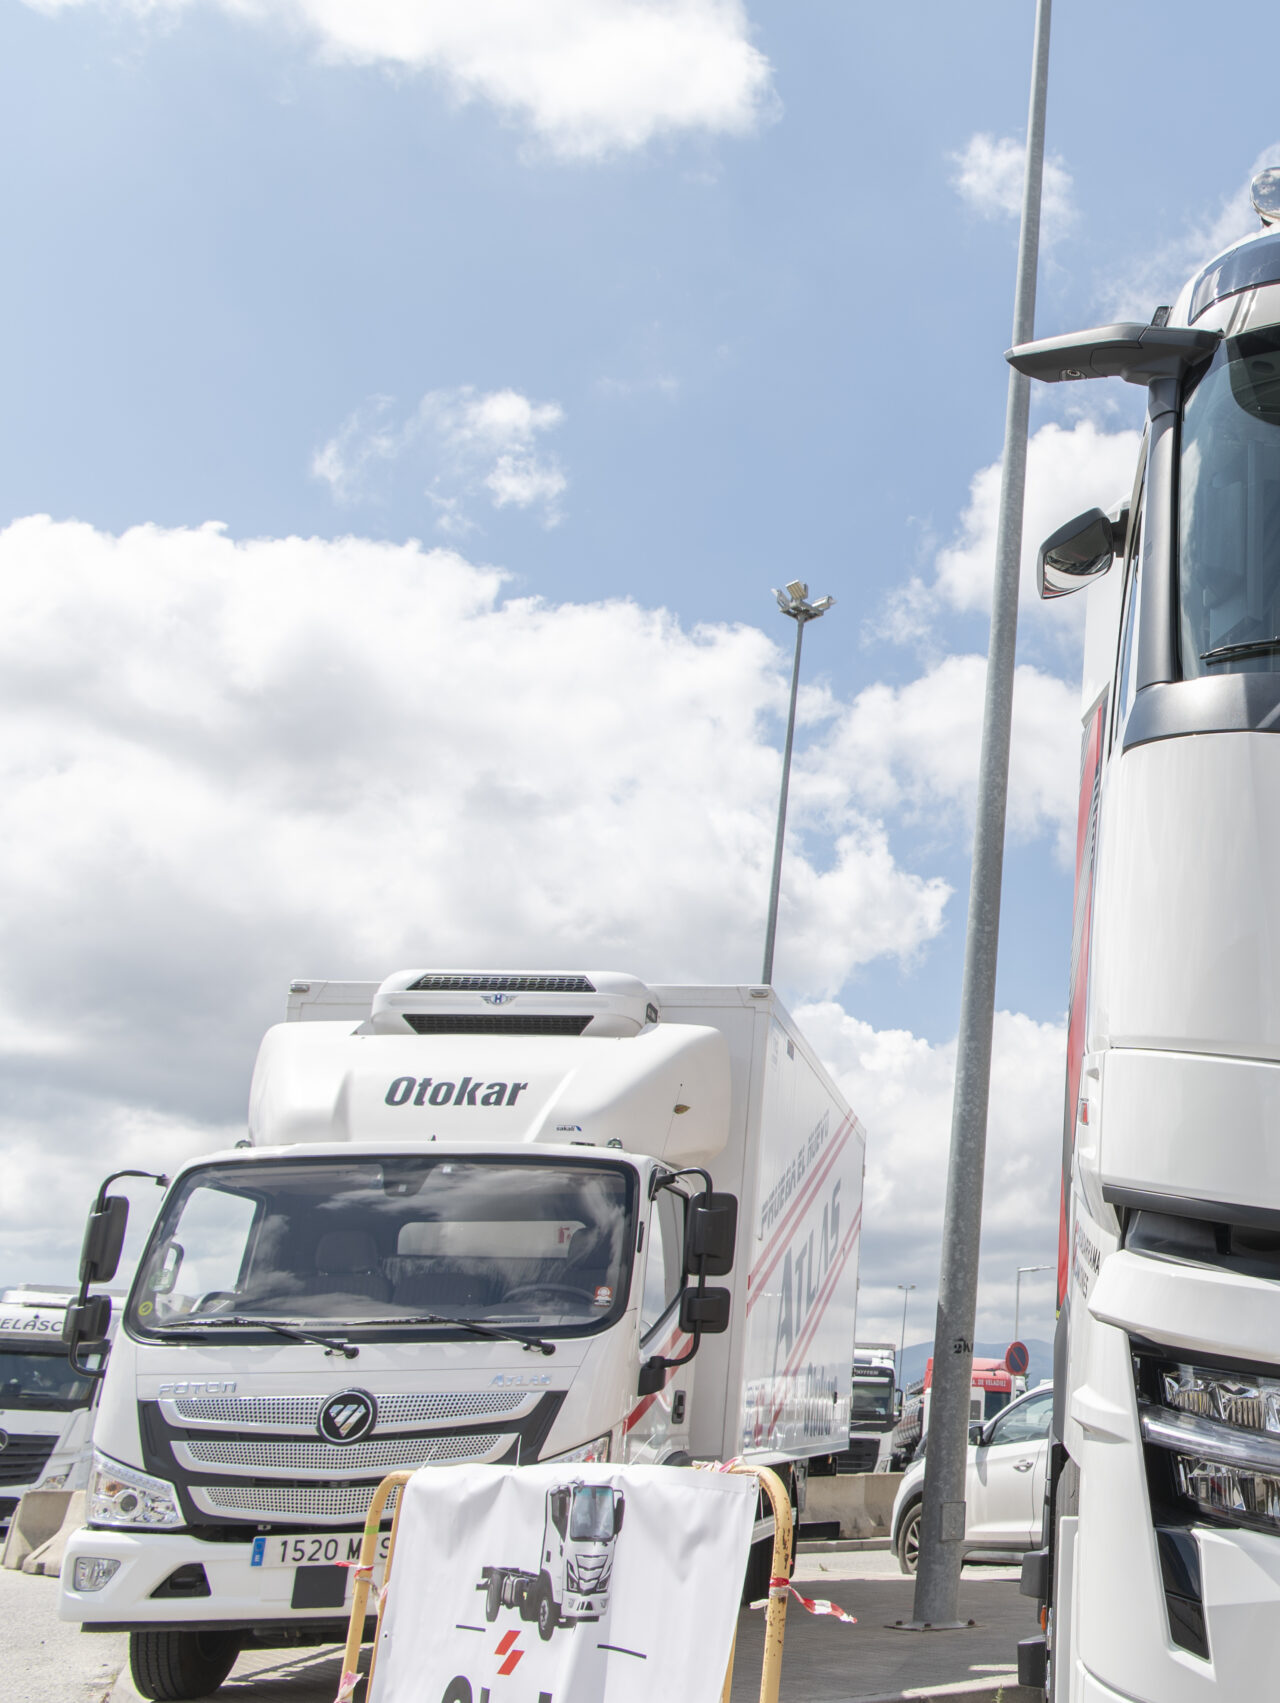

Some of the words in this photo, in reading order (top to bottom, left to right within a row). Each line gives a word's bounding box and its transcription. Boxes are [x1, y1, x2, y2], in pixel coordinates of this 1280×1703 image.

[384, 1076, 528, 1106] Otokar
[772, 1178, 841, 1378] ATLAS
[159, 1381, 237, 1396] FOTON
[280, 1538, 338, 1562] 1520
